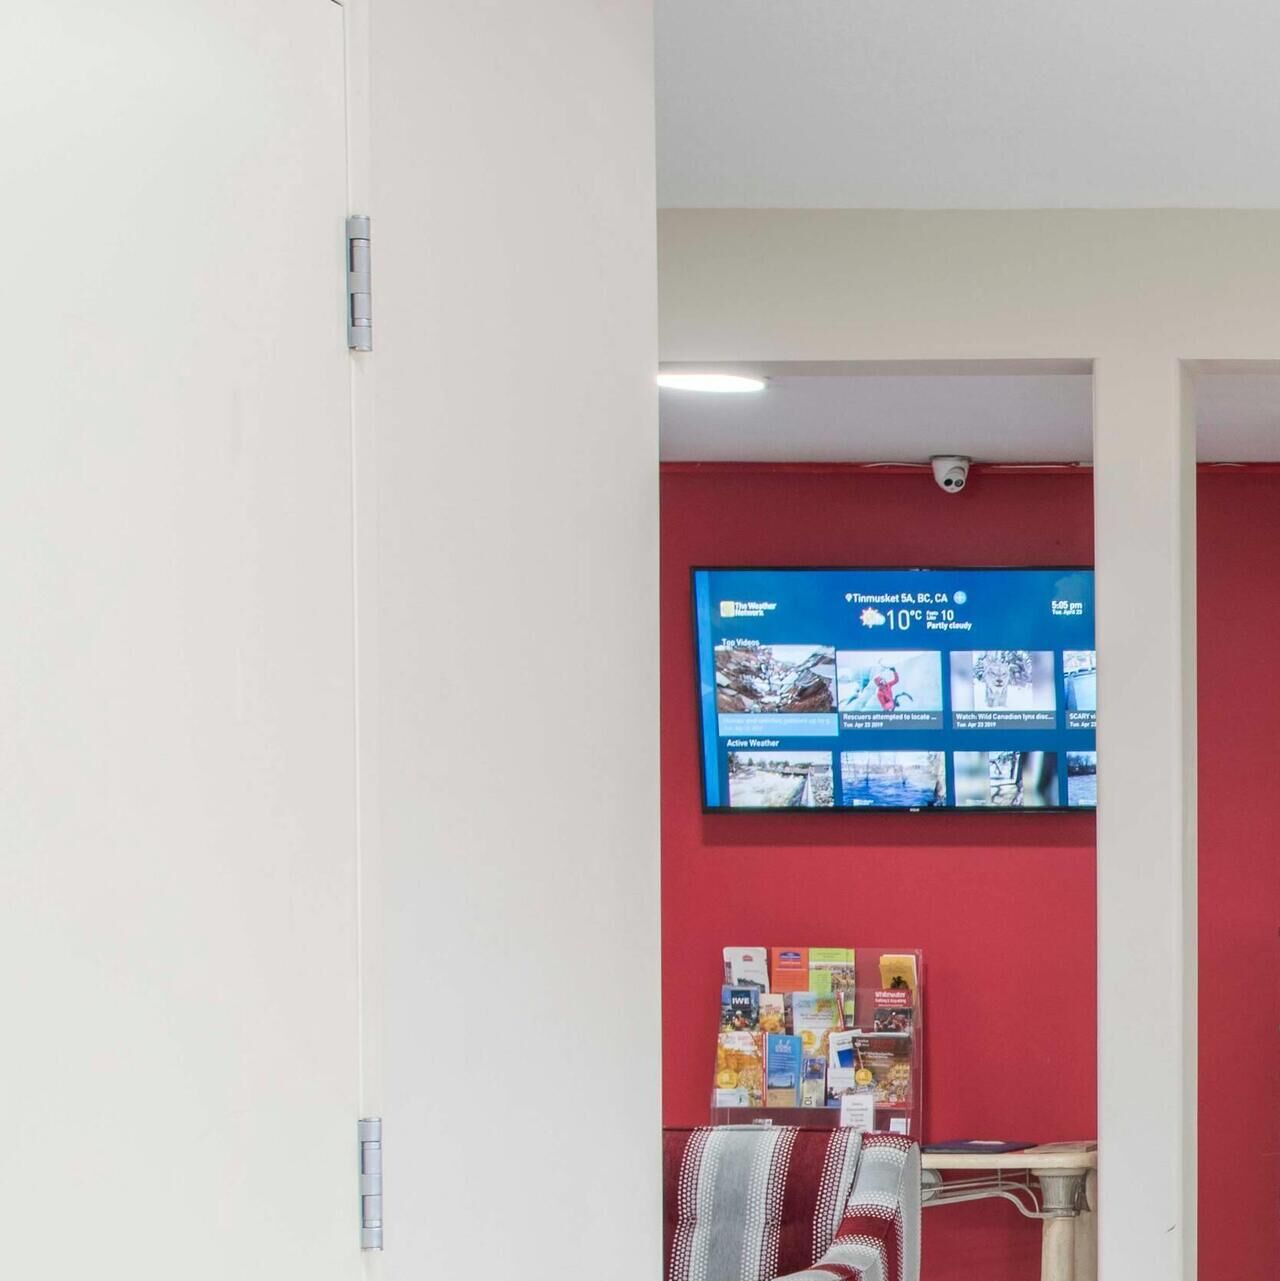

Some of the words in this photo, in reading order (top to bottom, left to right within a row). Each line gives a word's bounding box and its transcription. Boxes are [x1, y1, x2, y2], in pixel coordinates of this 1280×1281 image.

[853, 593, 899, 603] Tinmusket
[917, 593, 933, 604] BC,
[935, 593, 948, 603] CA
[1070, 602, 1083, 610] pm
[941, 609, 954, 621] 10
[927, 622, 948, 631] Partly
[949, 622, 972, 631] cloudy
[721, 638, 735, 647] Top
[736, 638, 760, 647] Videos
[727, 739, 748, 747] Active
[749, 739, 780, 747] Weather
